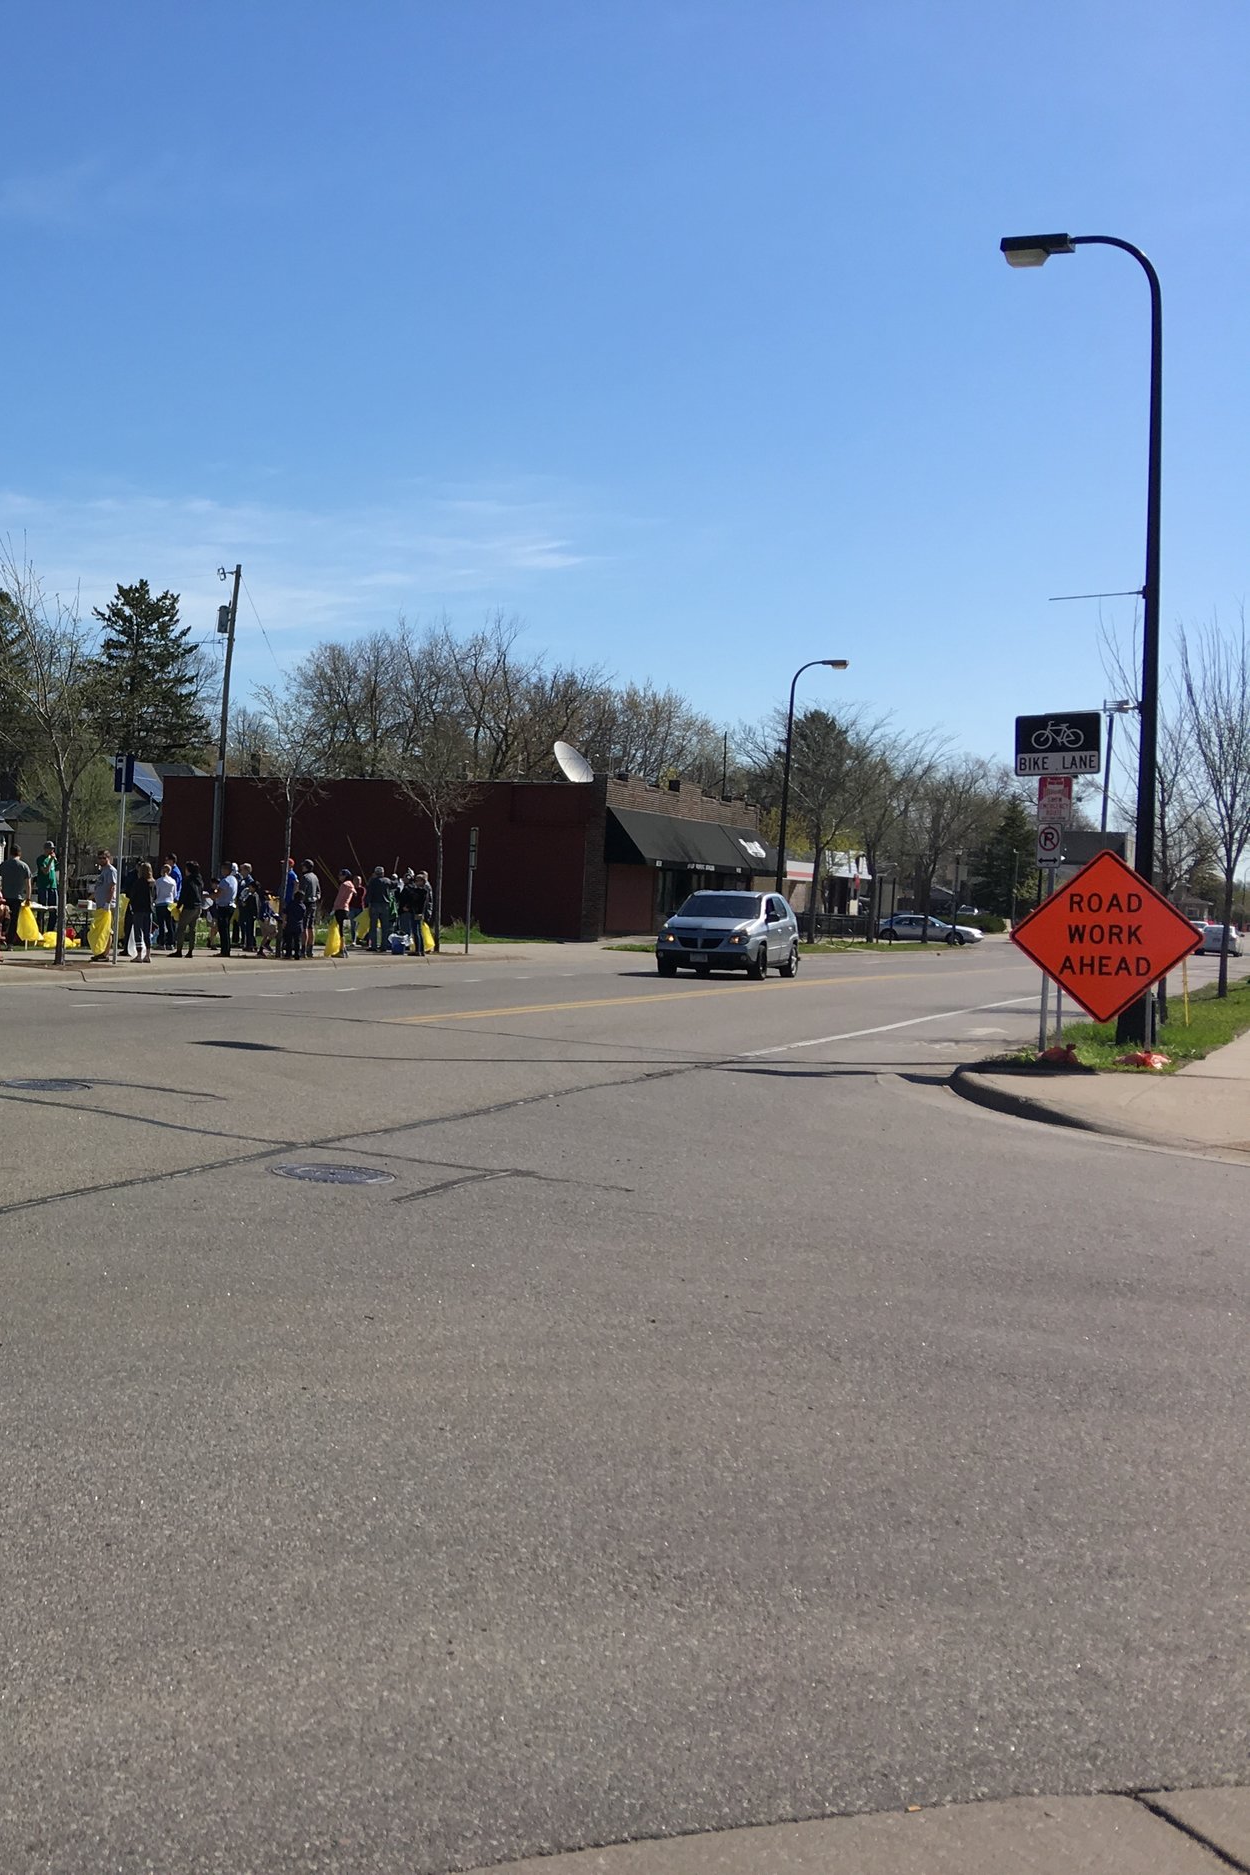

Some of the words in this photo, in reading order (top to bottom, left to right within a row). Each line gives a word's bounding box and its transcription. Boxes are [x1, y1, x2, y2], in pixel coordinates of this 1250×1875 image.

[1019, 756, 1049, 772] BIKE
[1062, 754, 1097, 769] LANE
[1069, 893, 1143, 913] ROAD
[1068, 924, 1143, 945] WORK
[1058, 955, 1152, 977] AHEAD
